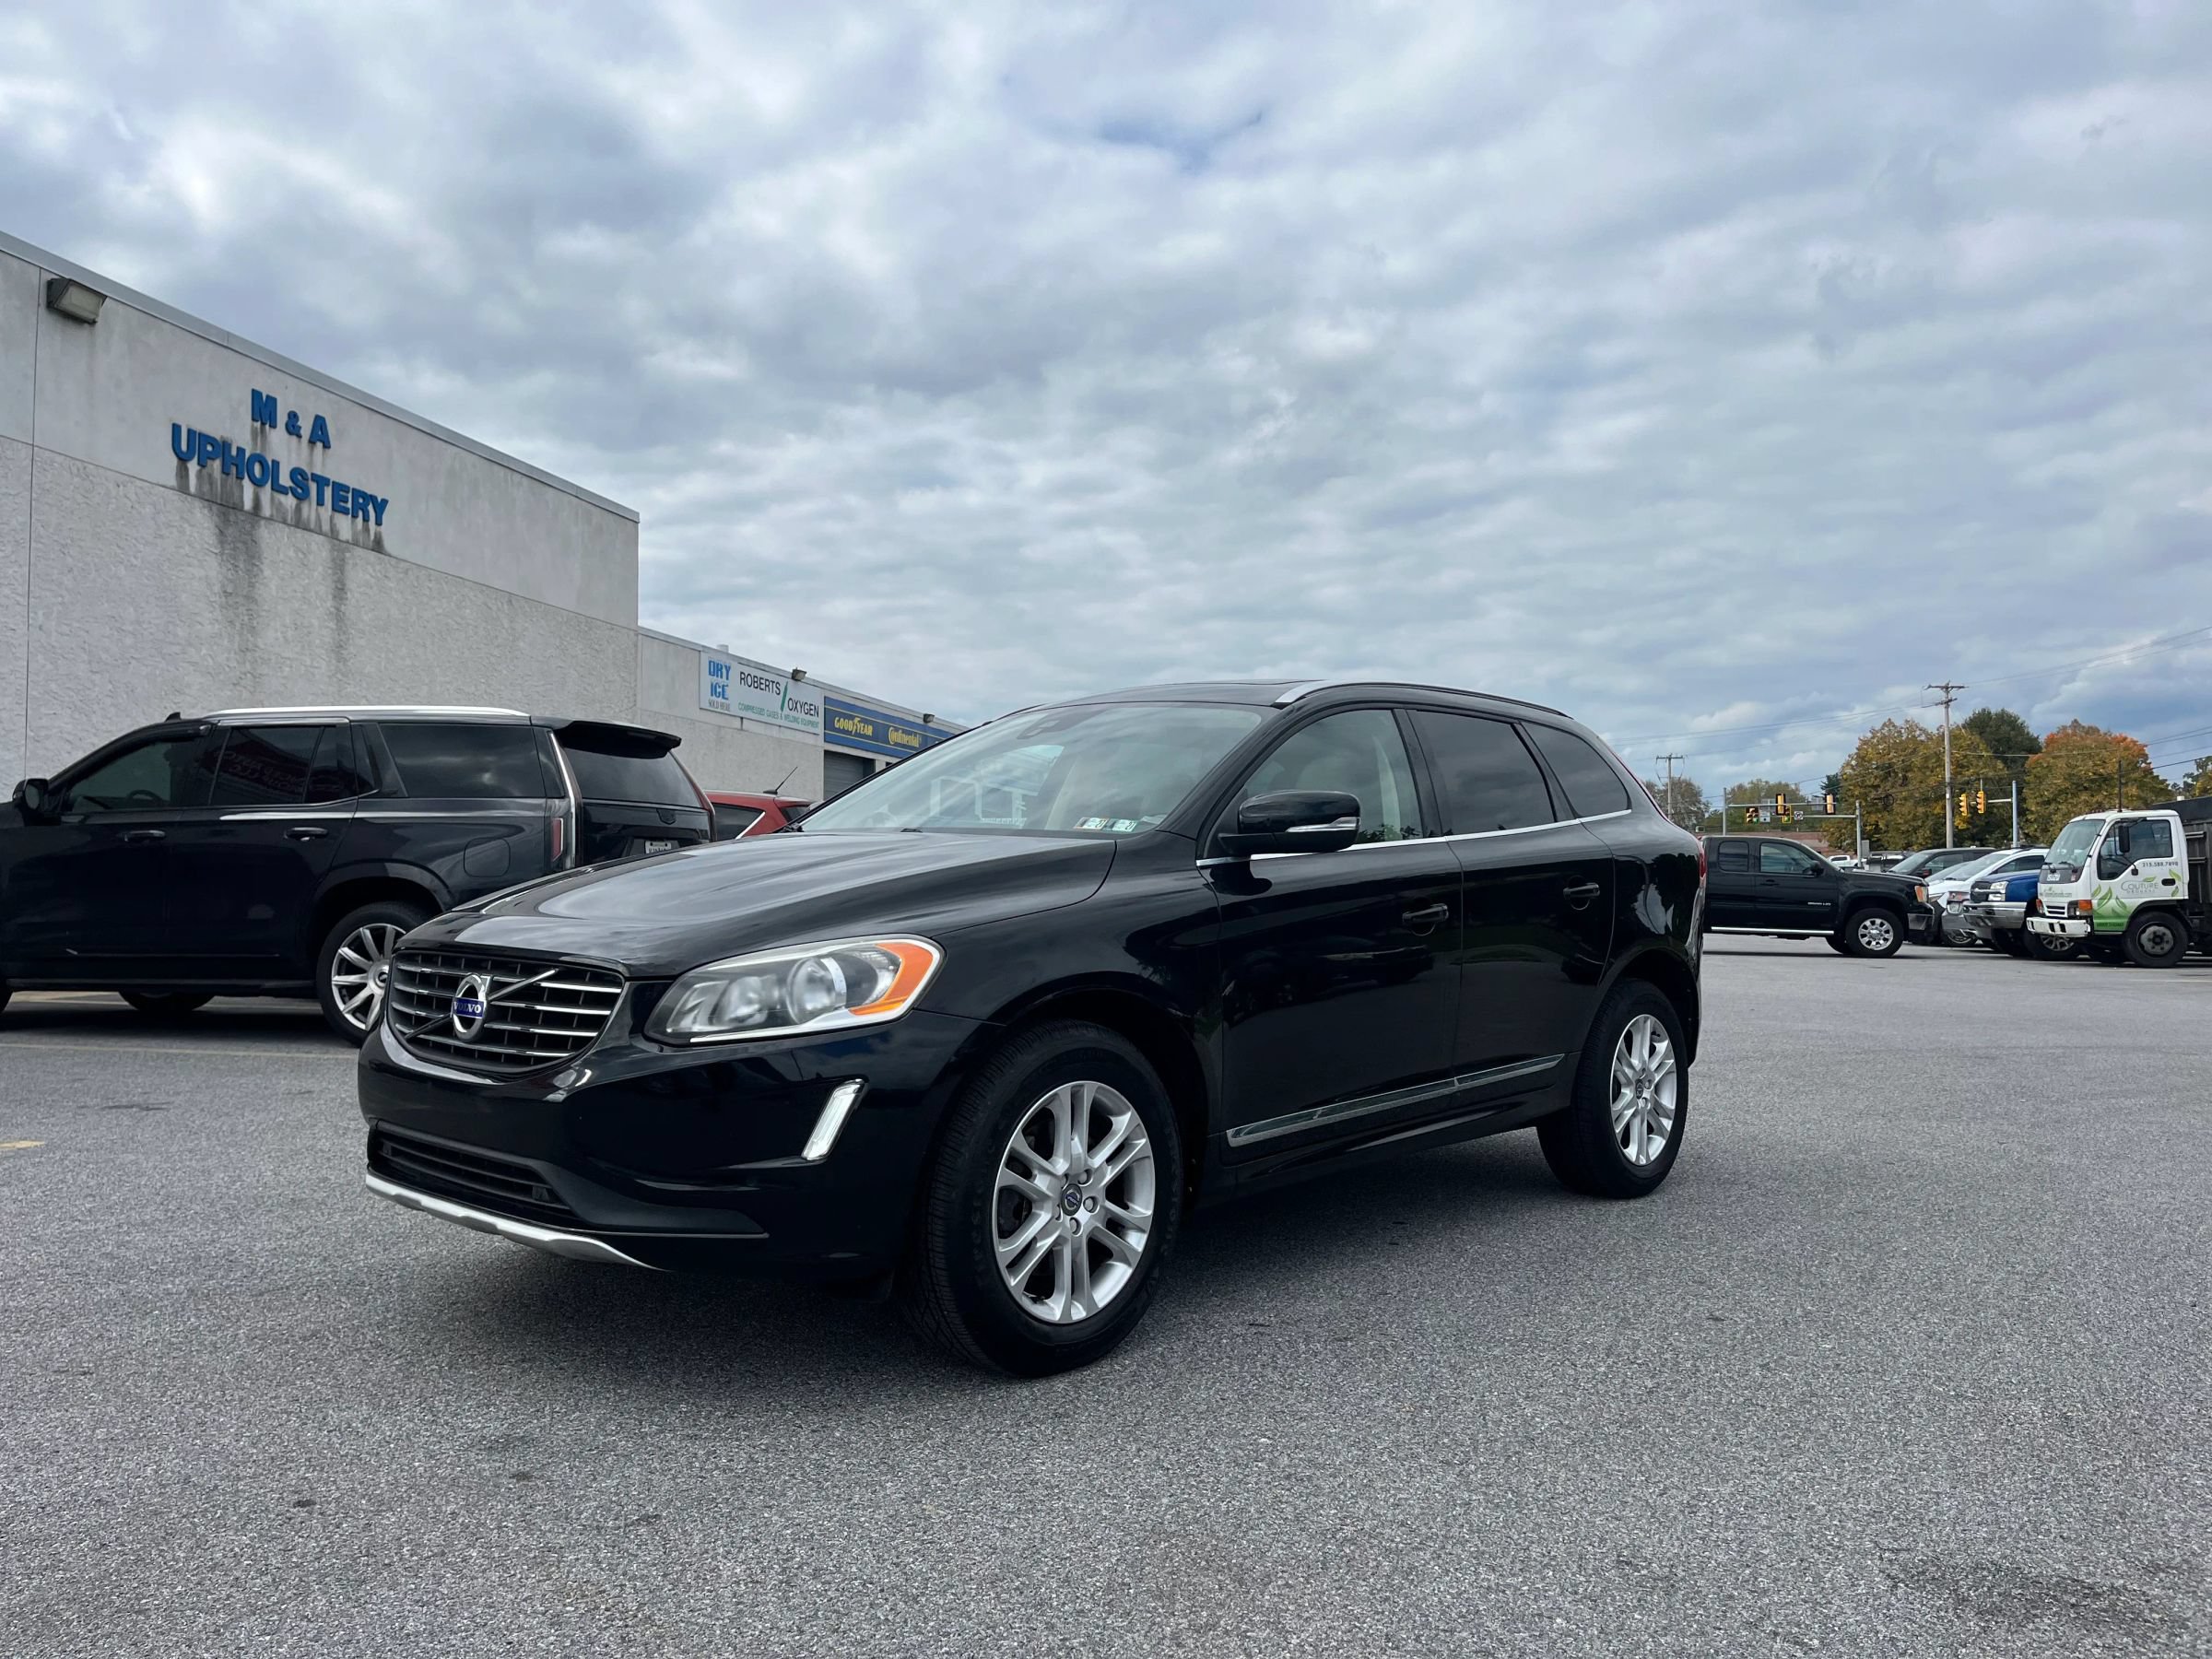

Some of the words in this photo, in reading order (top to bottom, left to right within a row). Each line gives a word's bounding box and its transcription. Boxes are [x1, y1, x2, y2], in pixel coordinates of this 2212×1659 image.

[251, 388, 277, 429] M
[286, 410, 302, 438] &
[309, 414, 331, 449] A
[171, 423, 389, 526] UPHOLSTERY
[708, 660, 731, 680] DRY
[711, 683, 729, 700] ICE
[740, 671, 781, 696] ROBERTS
[787, 698, 819, 718] OXYGEN
[834, 716, 873, 736] GOODYEAR
[888, 726, 920, 747] Continental
[453, 1001, 482, 1014] VOLVO
